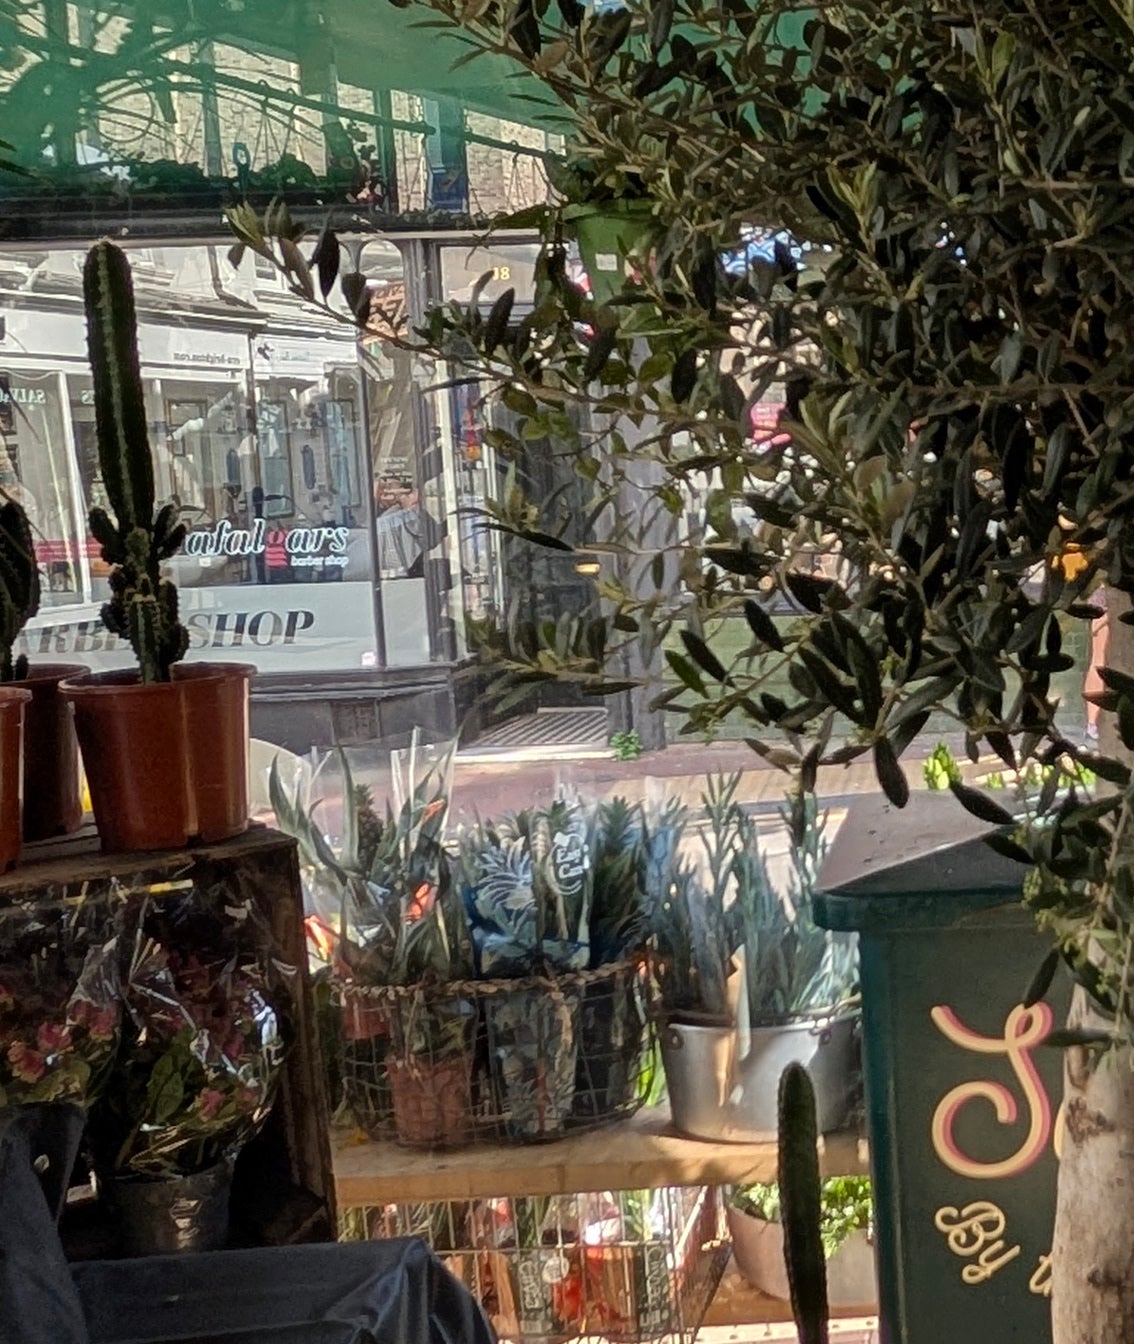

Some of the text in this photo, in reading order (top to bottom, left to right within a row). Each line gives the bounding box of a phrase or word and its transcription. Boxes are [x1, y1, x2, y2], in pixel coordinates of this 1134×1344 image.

[493, 266, 510, 280] 18
[186, 517, 350, 567] afalgars
[325, 555, 350, 567] shop
[187, 610, 314, 649] SHOP
[934, 1201, 1020, 1284] By
